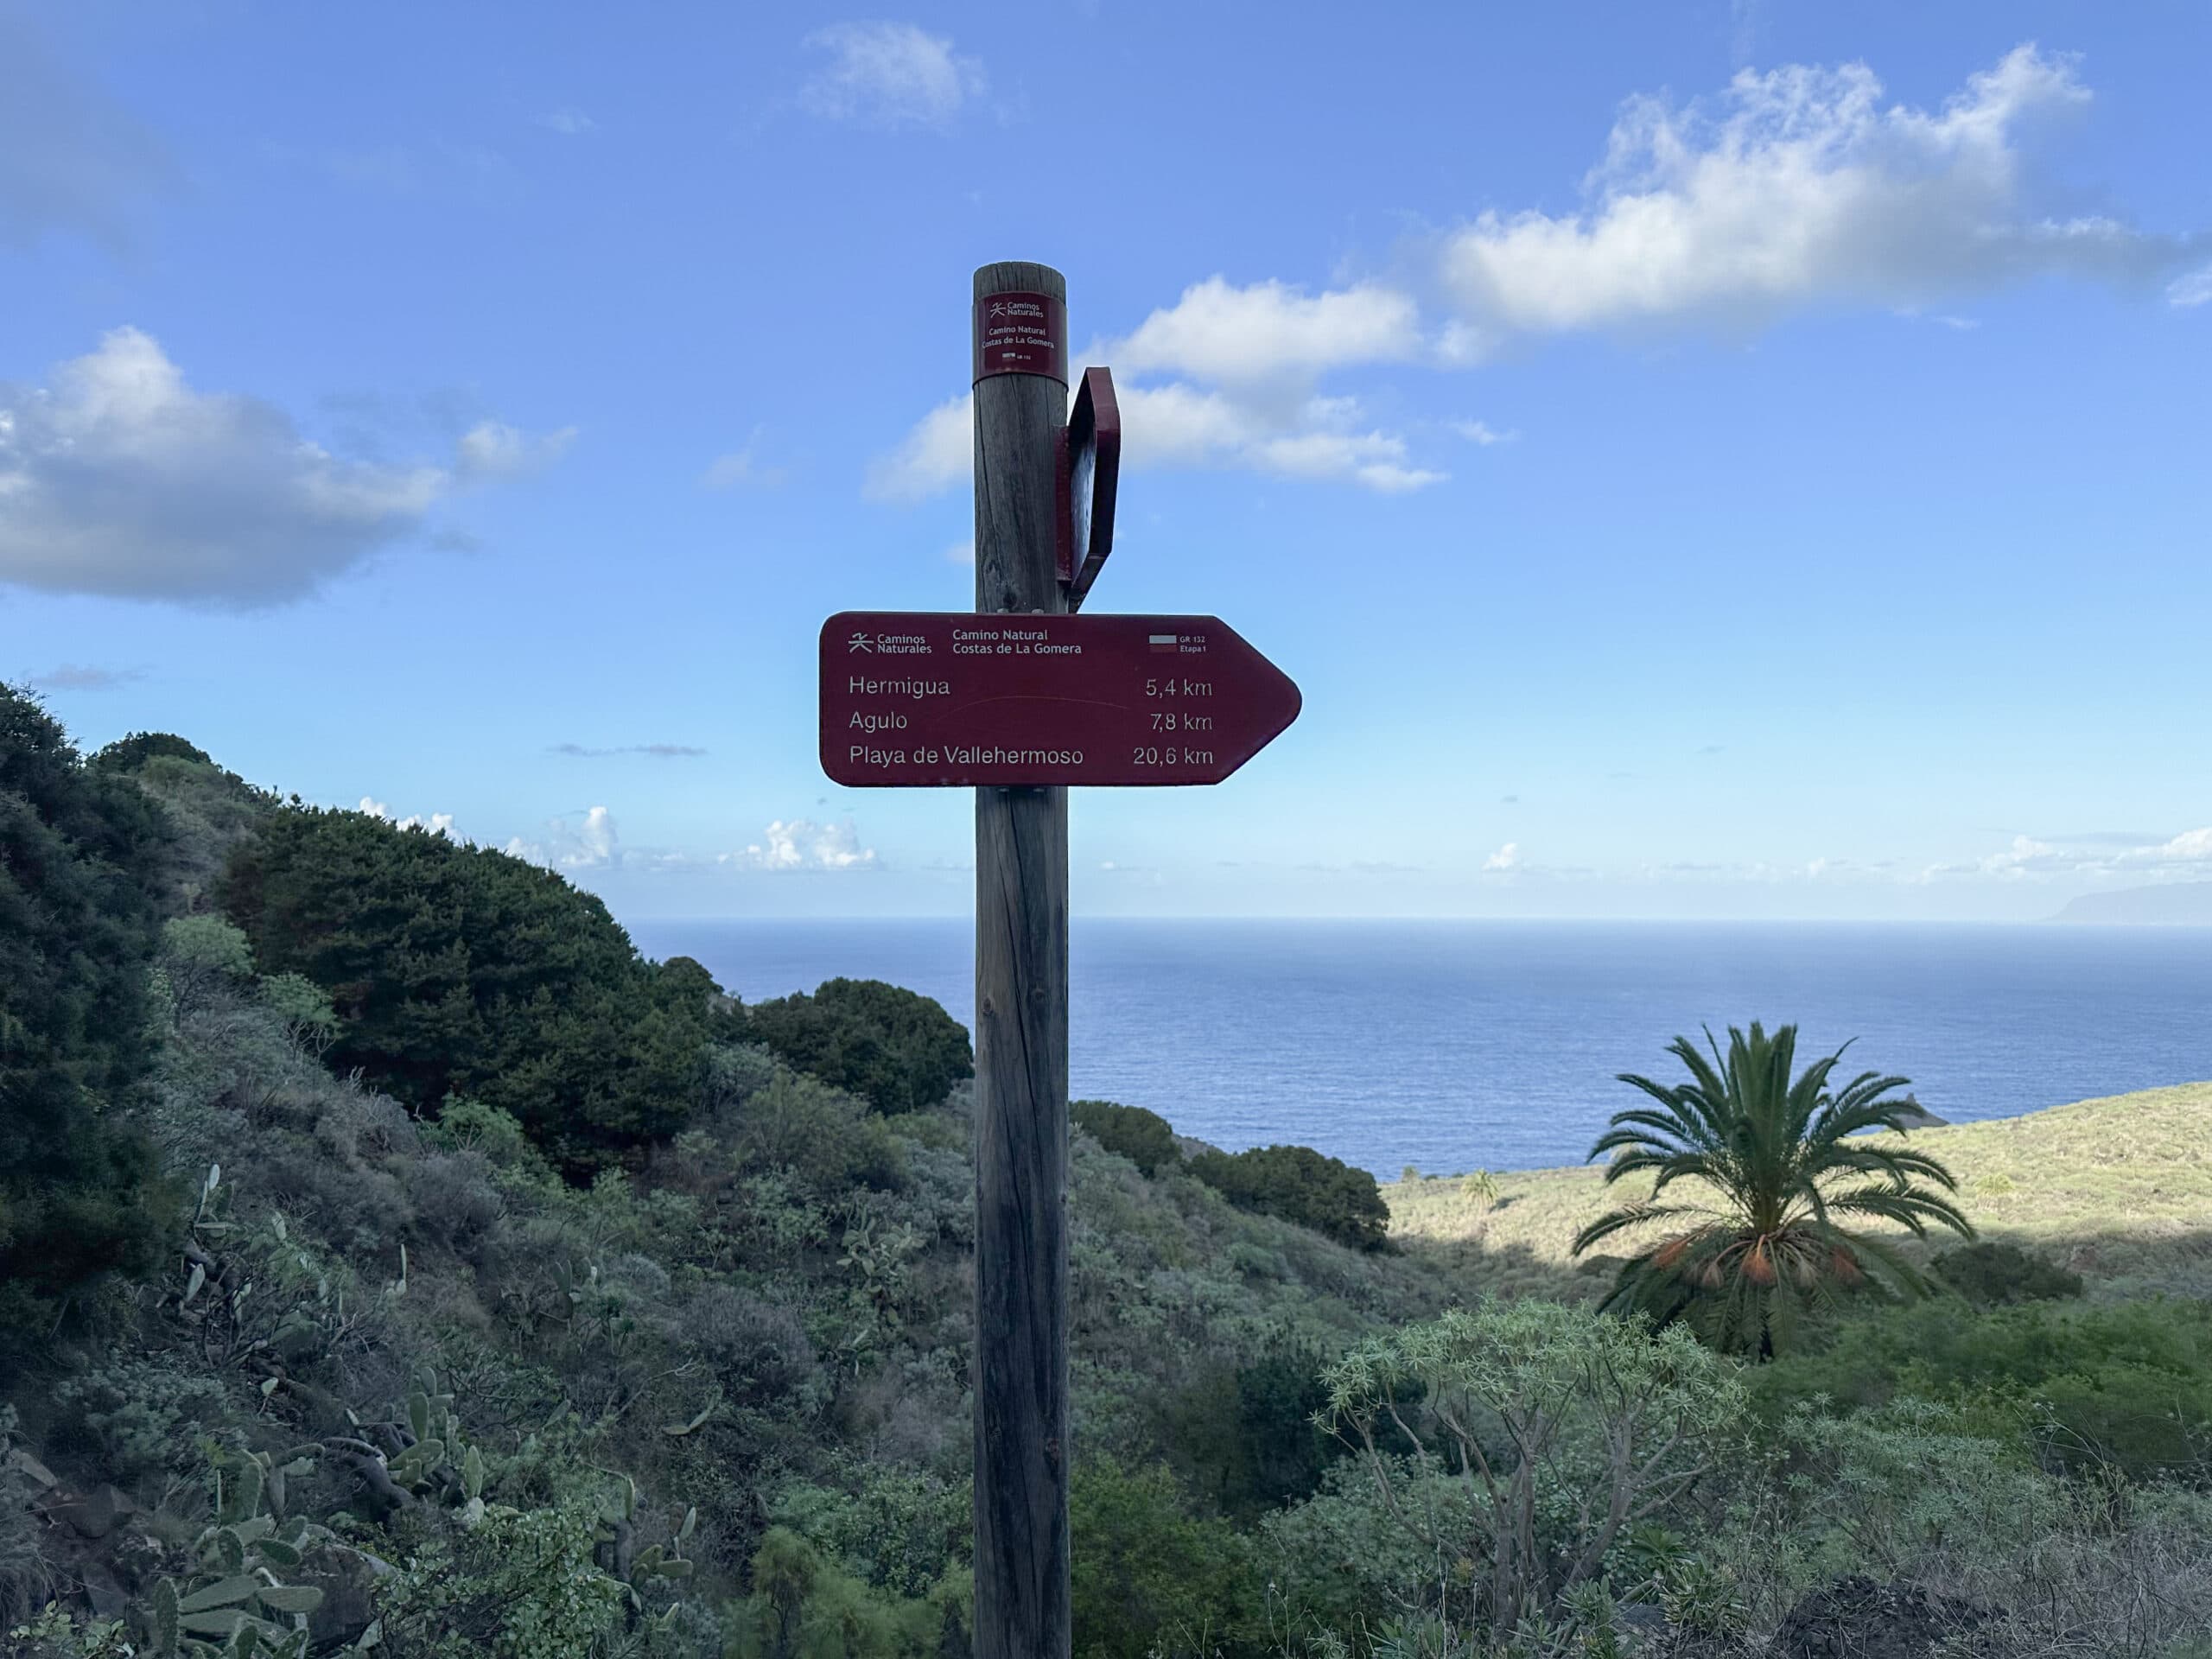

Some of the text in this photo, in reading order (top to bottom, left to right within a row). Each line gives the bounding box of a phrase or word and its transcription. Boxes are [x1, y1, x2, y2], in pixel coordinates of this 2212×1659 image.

[1007, 309, 1043, 318] Naturales
[989, 326, 1046, 335] Camino Natural
[982, 338, 1001, 349] Costas
[1027, 337, 1054, 349] Gomera
[878, 634, 925, 644] Caminos
[953, 630, 1048, 640] Camino Natural
[878, 644, 932, 653] Naturales
[953, 643, 1081, 654] Costas de La Gomera
[849, 677, 950, 698] Hermigua
[1146, 678, 1212, 698] 5,4 km
[849, 711, 907, 733] Agulo
[1151, 713, 1212, 732] 7,8 km
[850, 746, 1084, 767] Playa de Vallehermoso
[1134, 747, 1213, 766] 20,6 km
